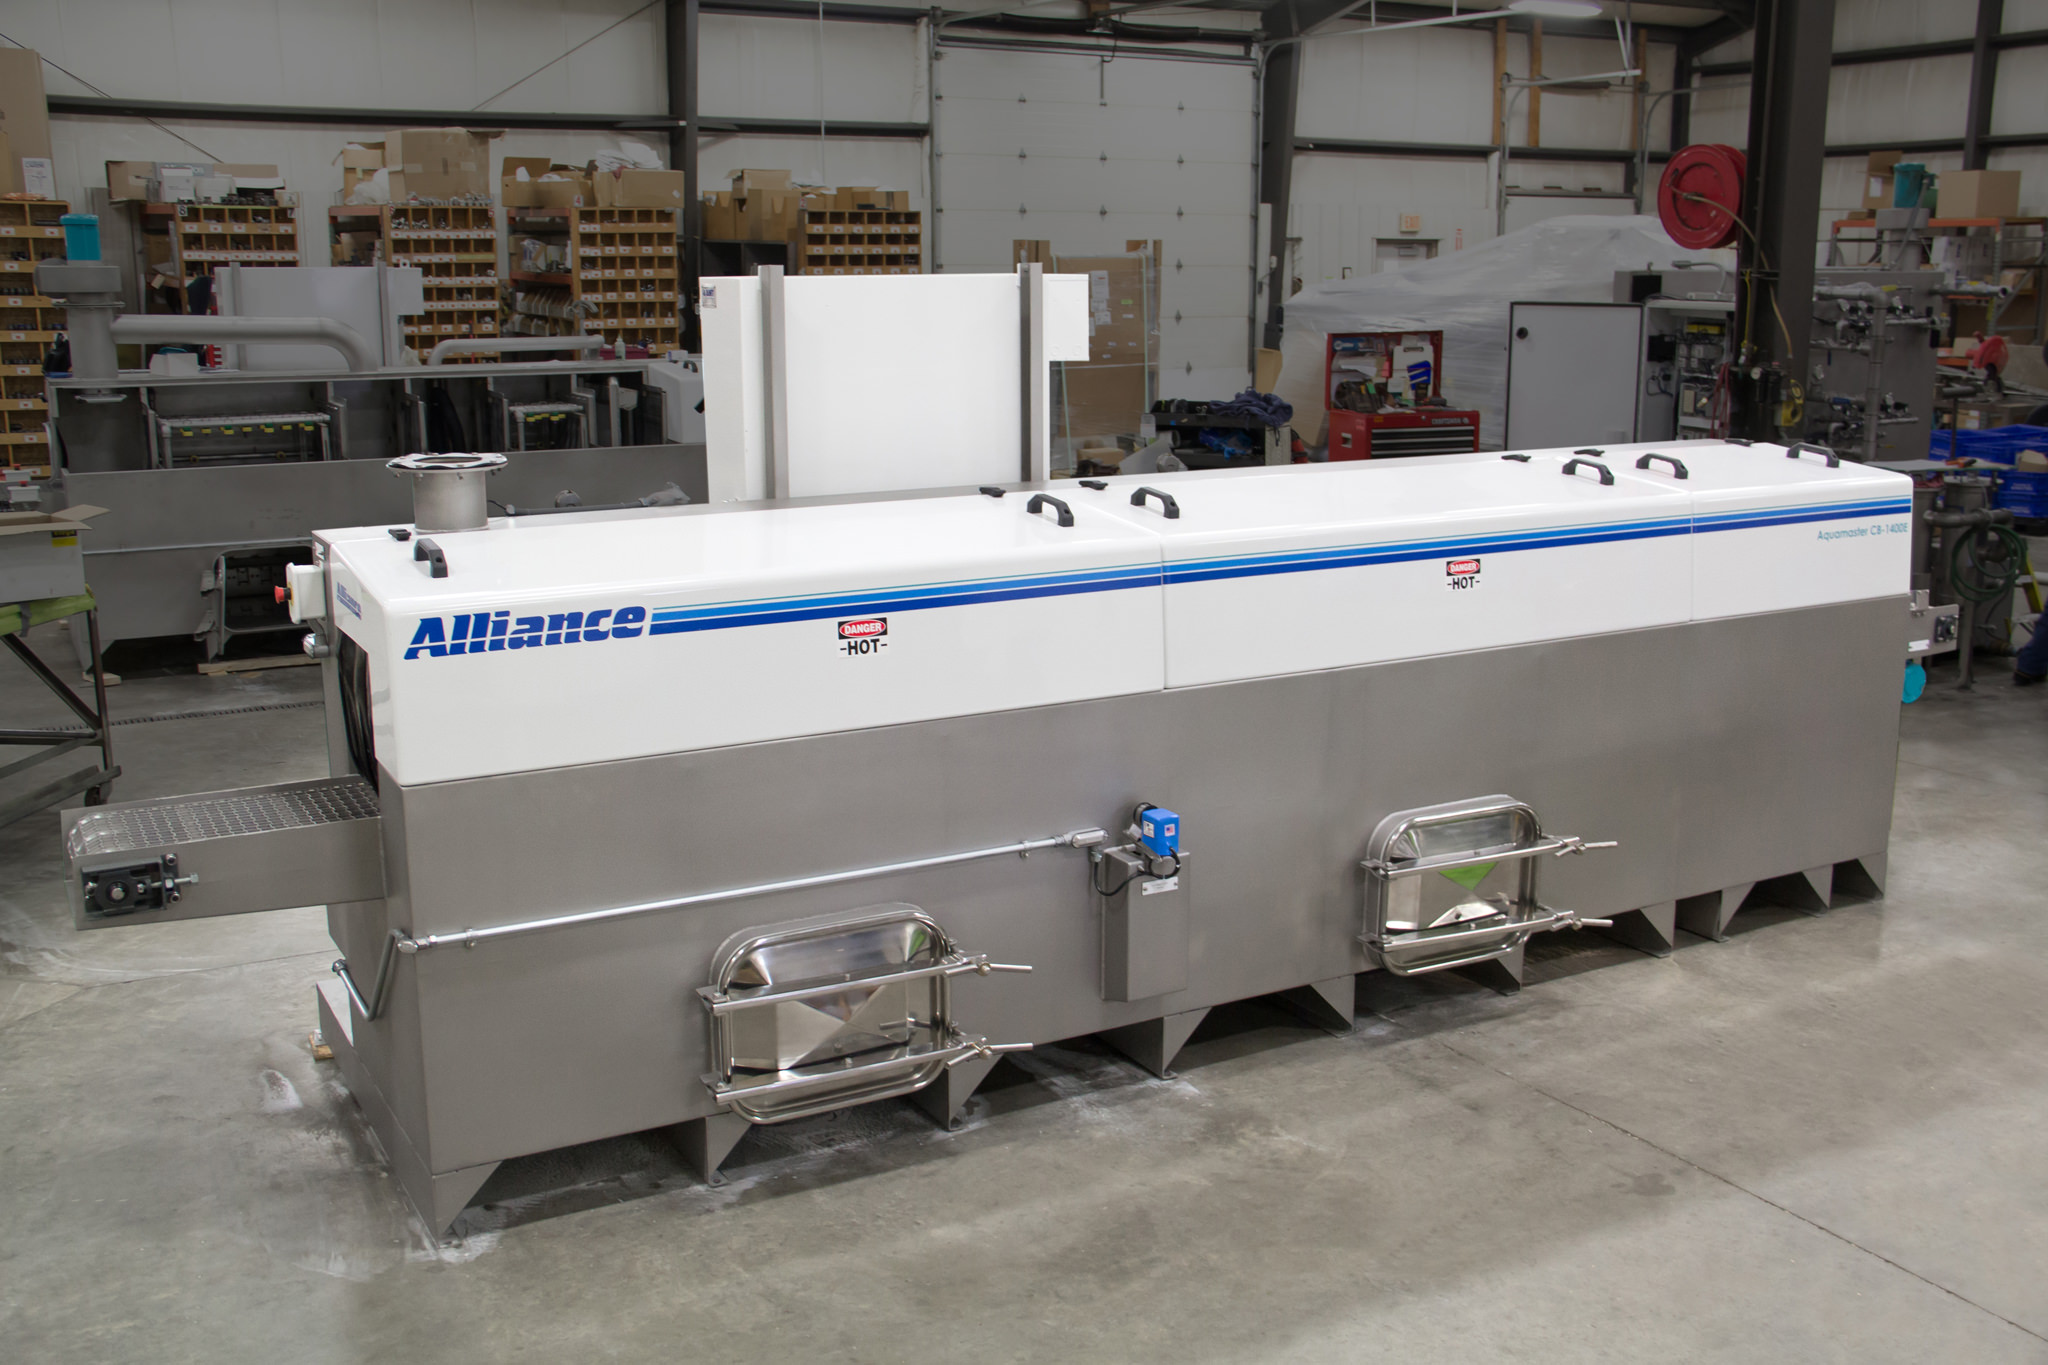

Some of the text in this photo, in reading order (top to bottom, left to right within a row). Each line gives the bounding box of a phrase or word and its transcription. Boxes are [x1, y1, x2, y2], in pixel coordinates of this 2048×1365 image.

[1817, 527, 1869, 542] Aquamaster
[1450, 562, 1477, 573] DANGER
[404, 606, 646, 660] Alliance
[844, 622, 882, 635] DANGER
